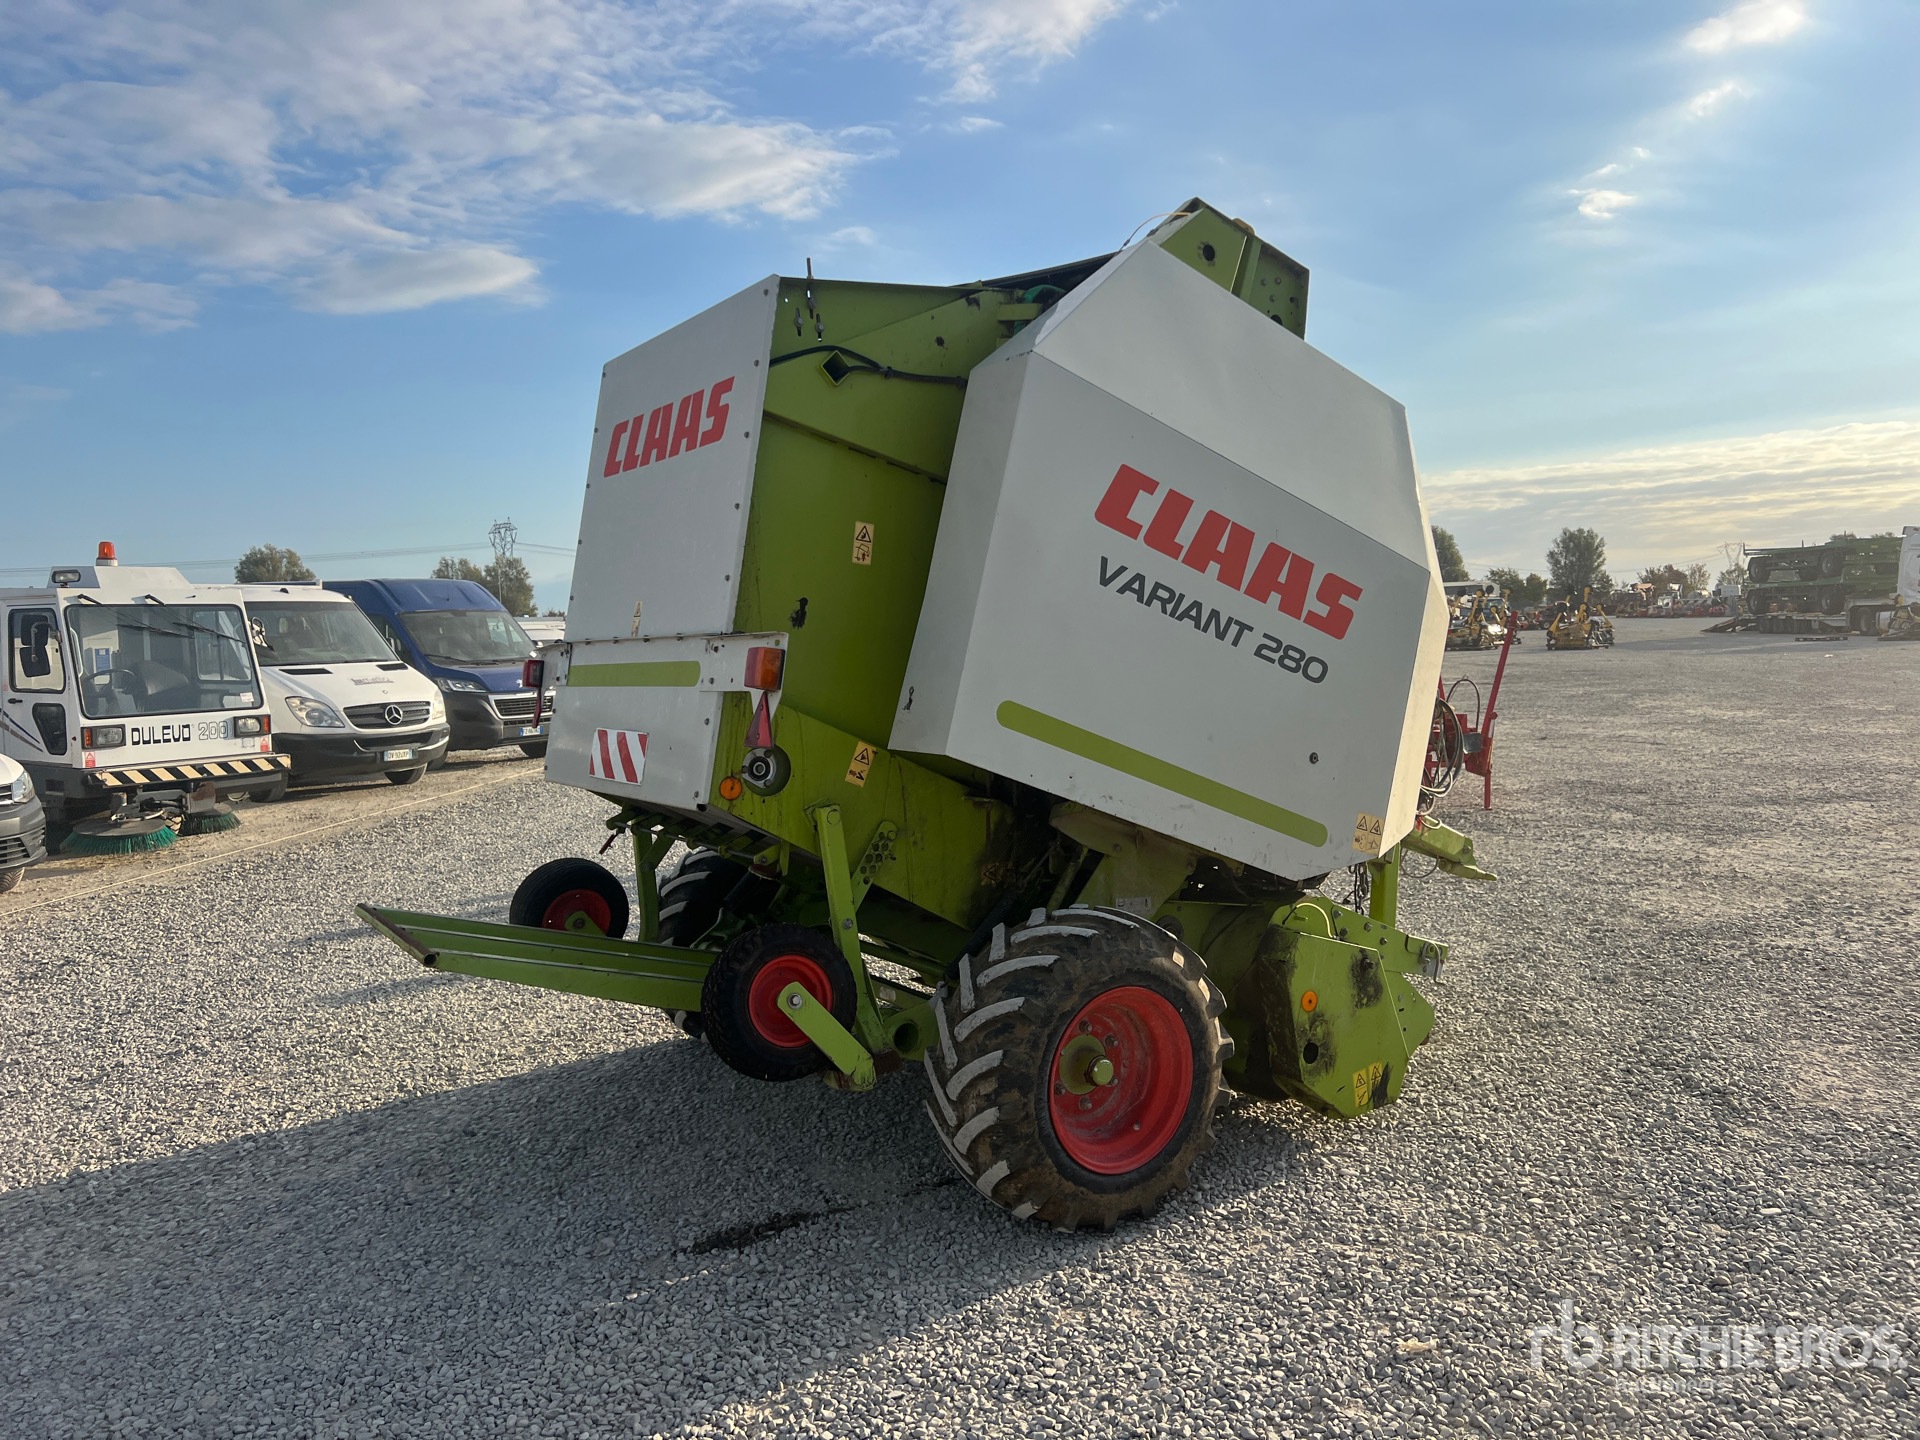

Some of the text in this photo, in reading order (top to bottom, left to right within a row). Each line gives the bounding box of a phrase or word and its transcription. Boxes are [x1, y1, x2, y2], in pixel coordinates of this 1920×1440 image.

[603, 375, 735, 478] CLAAS
[1094, 463, 1364, 641] CLAAS
[1099, 555, 1330, 684] VARIANT 280
[131, 721, 228, 746] DULEVO 200
